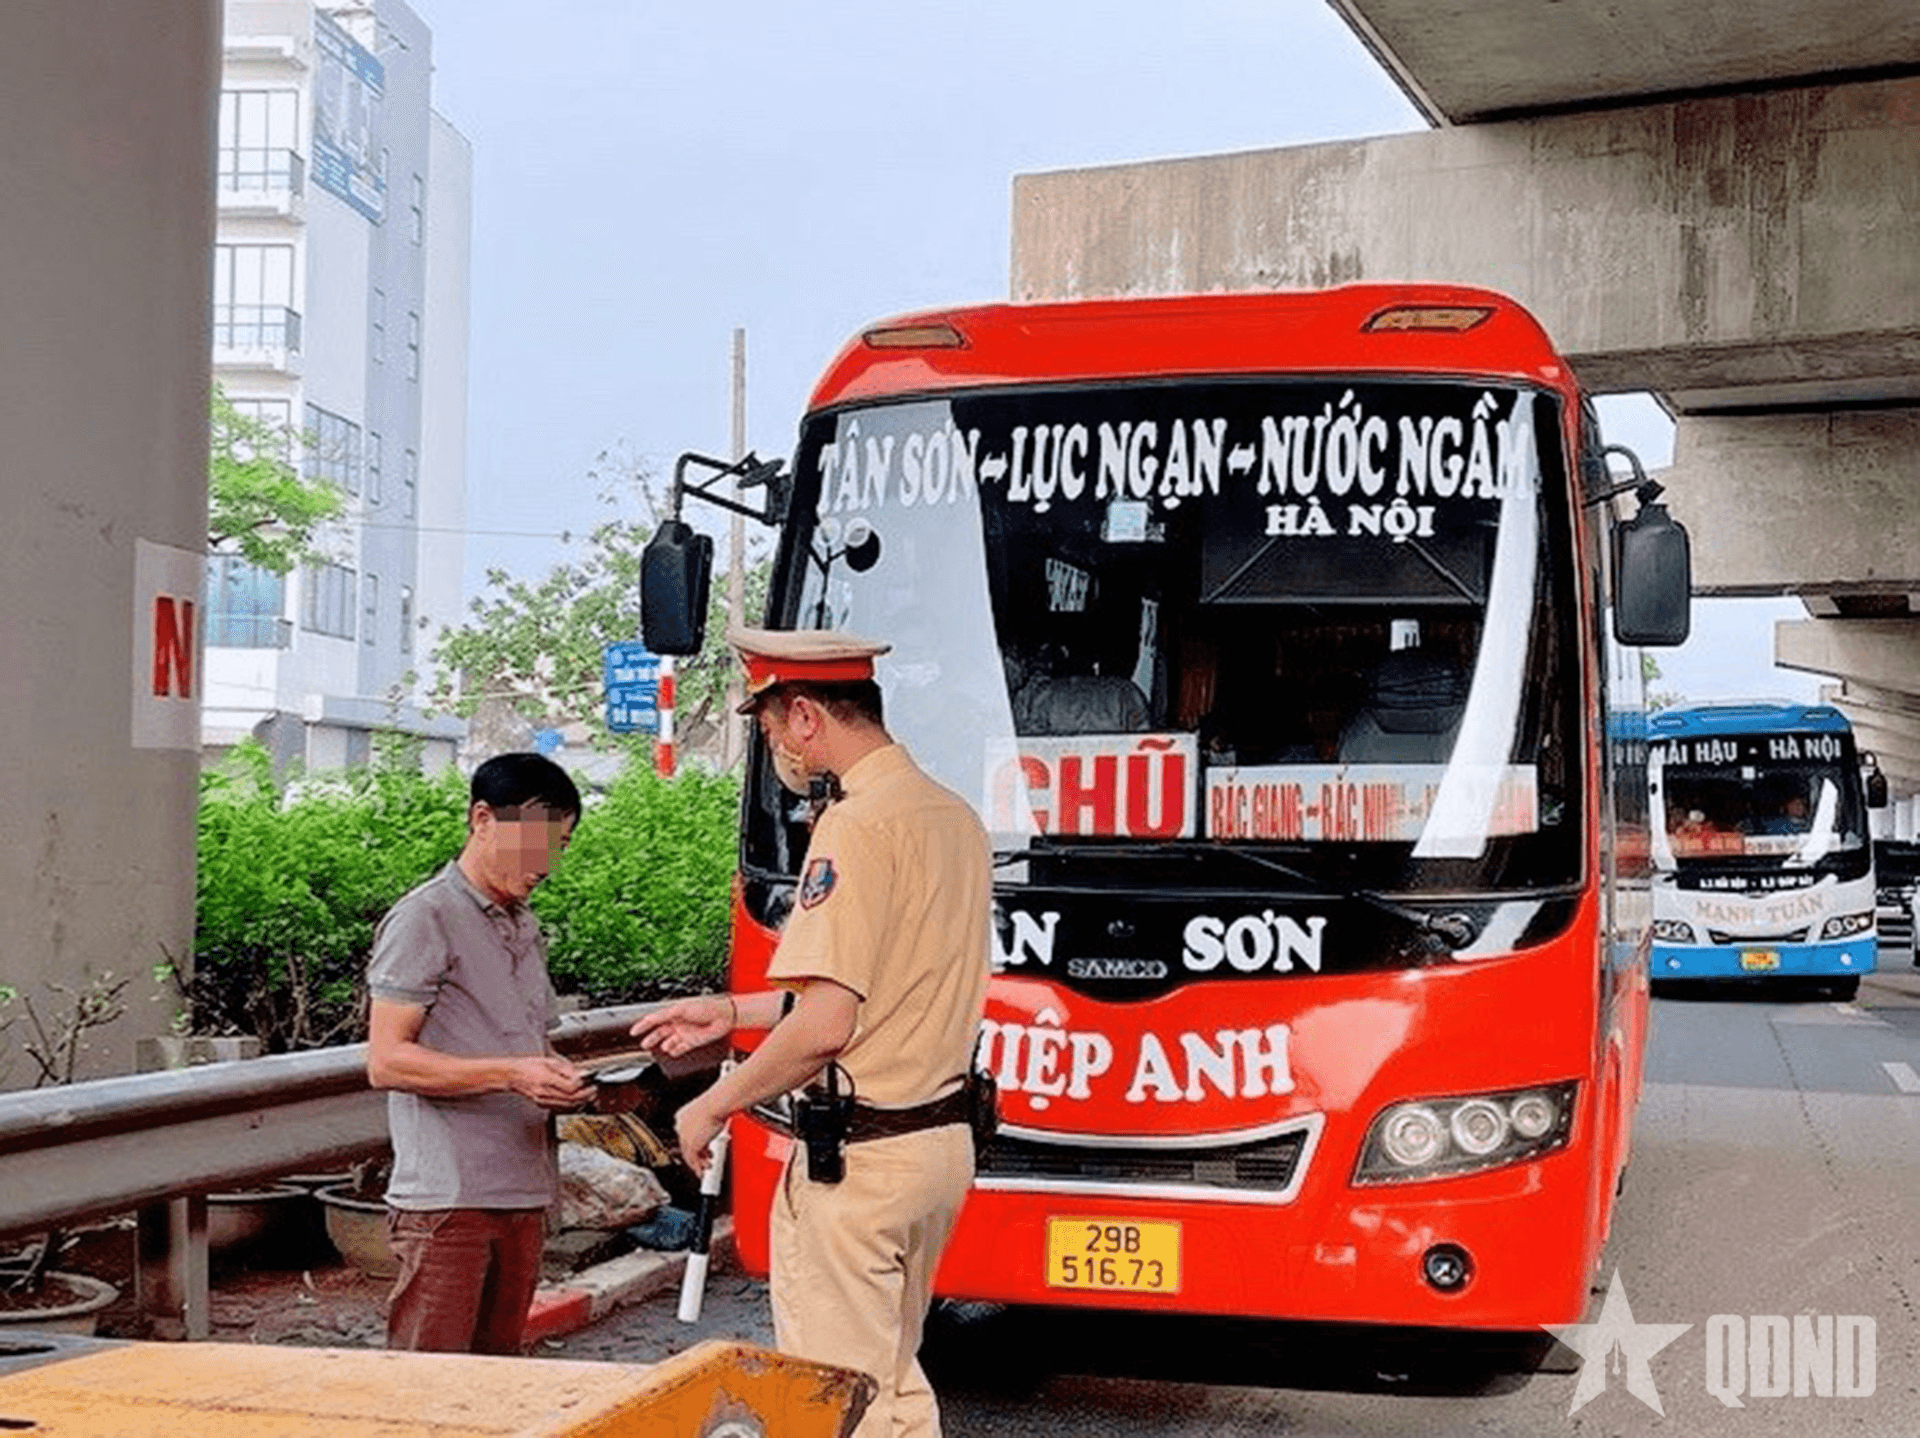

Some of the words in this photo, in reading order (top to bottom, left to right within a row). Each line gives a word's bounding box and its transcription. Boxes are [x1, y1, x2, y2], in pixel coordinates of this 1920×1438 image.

[816, 419, 895, 515] TÂN
[900, 418, 981, 507] SƠN
[1007, 424, 1089, 513] LỤC
[1095, 418, 1227, 510] NGẠN
[1257, 389, 1388, 496] NƯỚC
[1396, 391, 1534, 499] NGẦM
[1264, 496, 1337, 536] HÀ
[1347, 498, 1436, 543] NỘI
[153, 595, 195, 699] N
[1695, 739, 1738, 765] HẬU
[1769, 734, 1800, 760] HÀ
[1804, 734, 1842, 762] NỘI
[991, 738, 1185, 838] CHŨ
[1067, 957, 1168, 979] SAMCO
[1182, 908, 1329, 973] SƠN
[1125, 1023, 1297, 1103] ANH
[1085, 1224, 1141, 1253] 29B
[1061, 1255, 1164, 1288] 516.73
